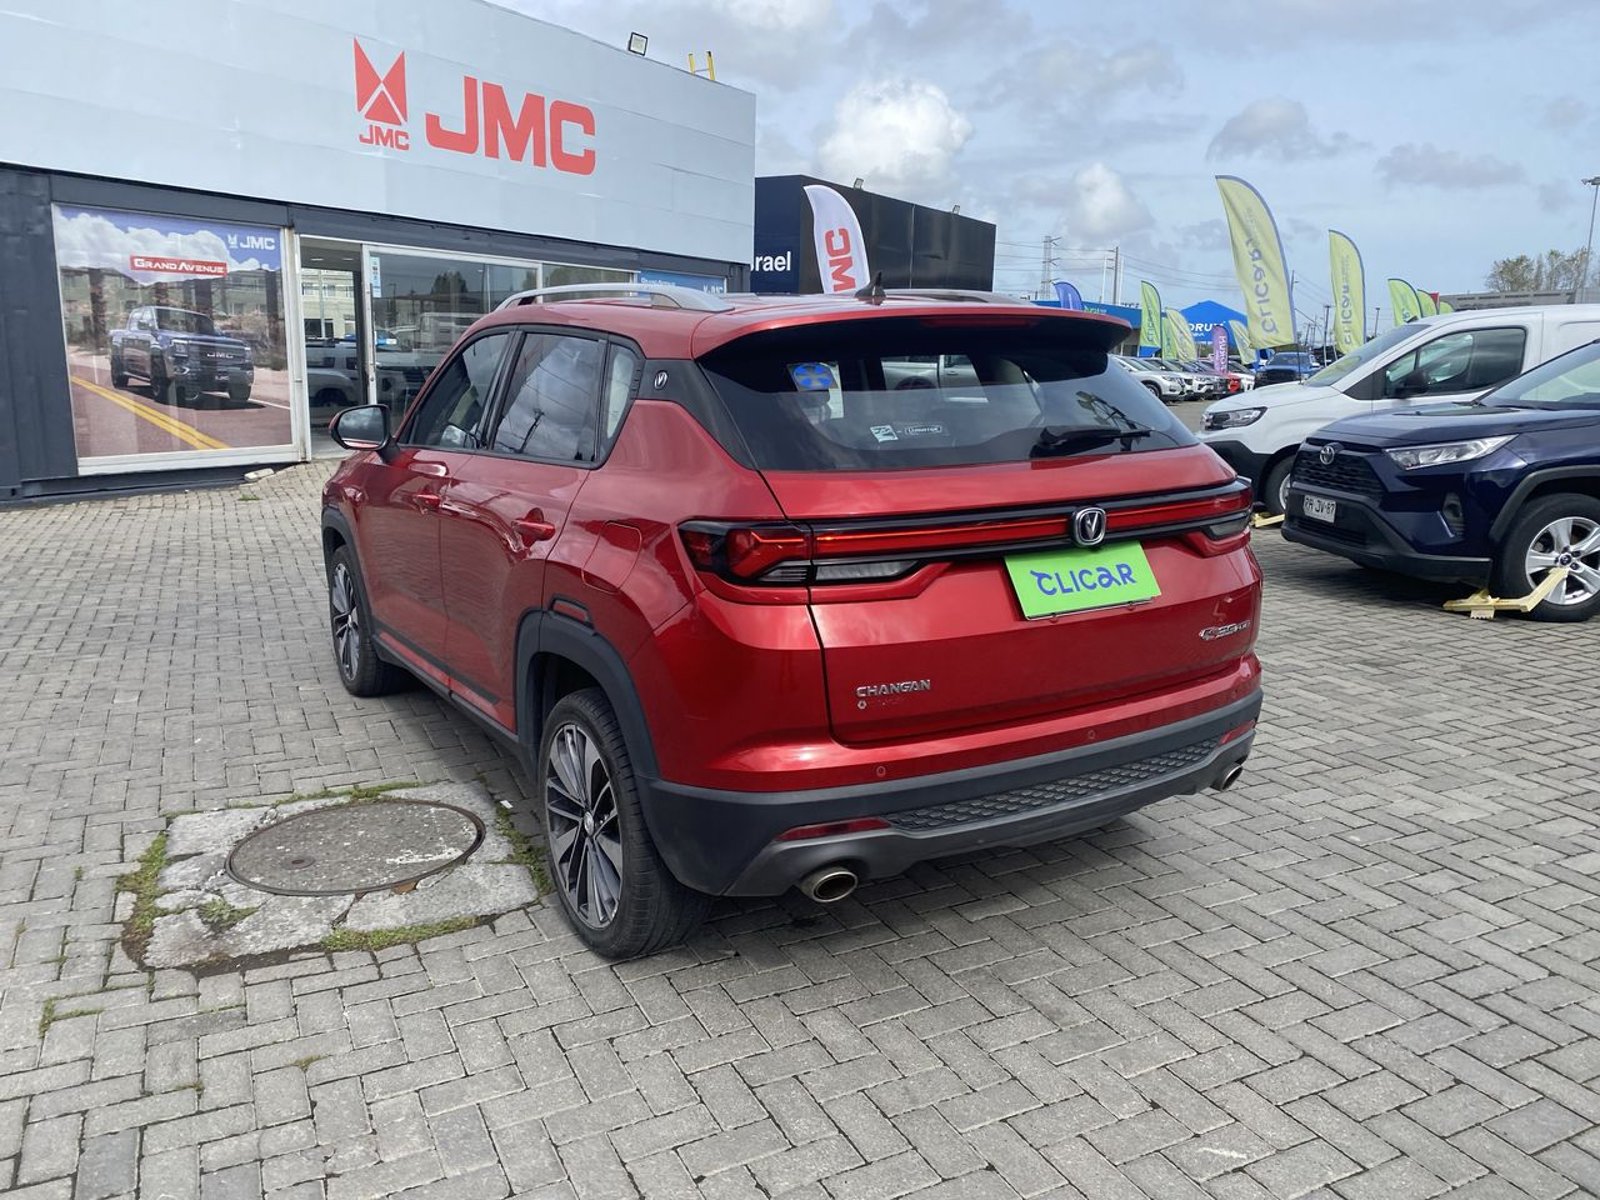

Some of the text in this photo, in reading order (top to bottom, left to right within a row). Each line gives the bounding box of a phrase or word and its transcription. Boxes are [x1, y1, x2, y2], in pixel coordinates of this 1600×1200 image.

[425, 75, 596, 176] JMC
[359, 124, 410, 151] JMC
[240, 236, 276, 250] JMC
[856, 679, 931, 698] CHANGAN
